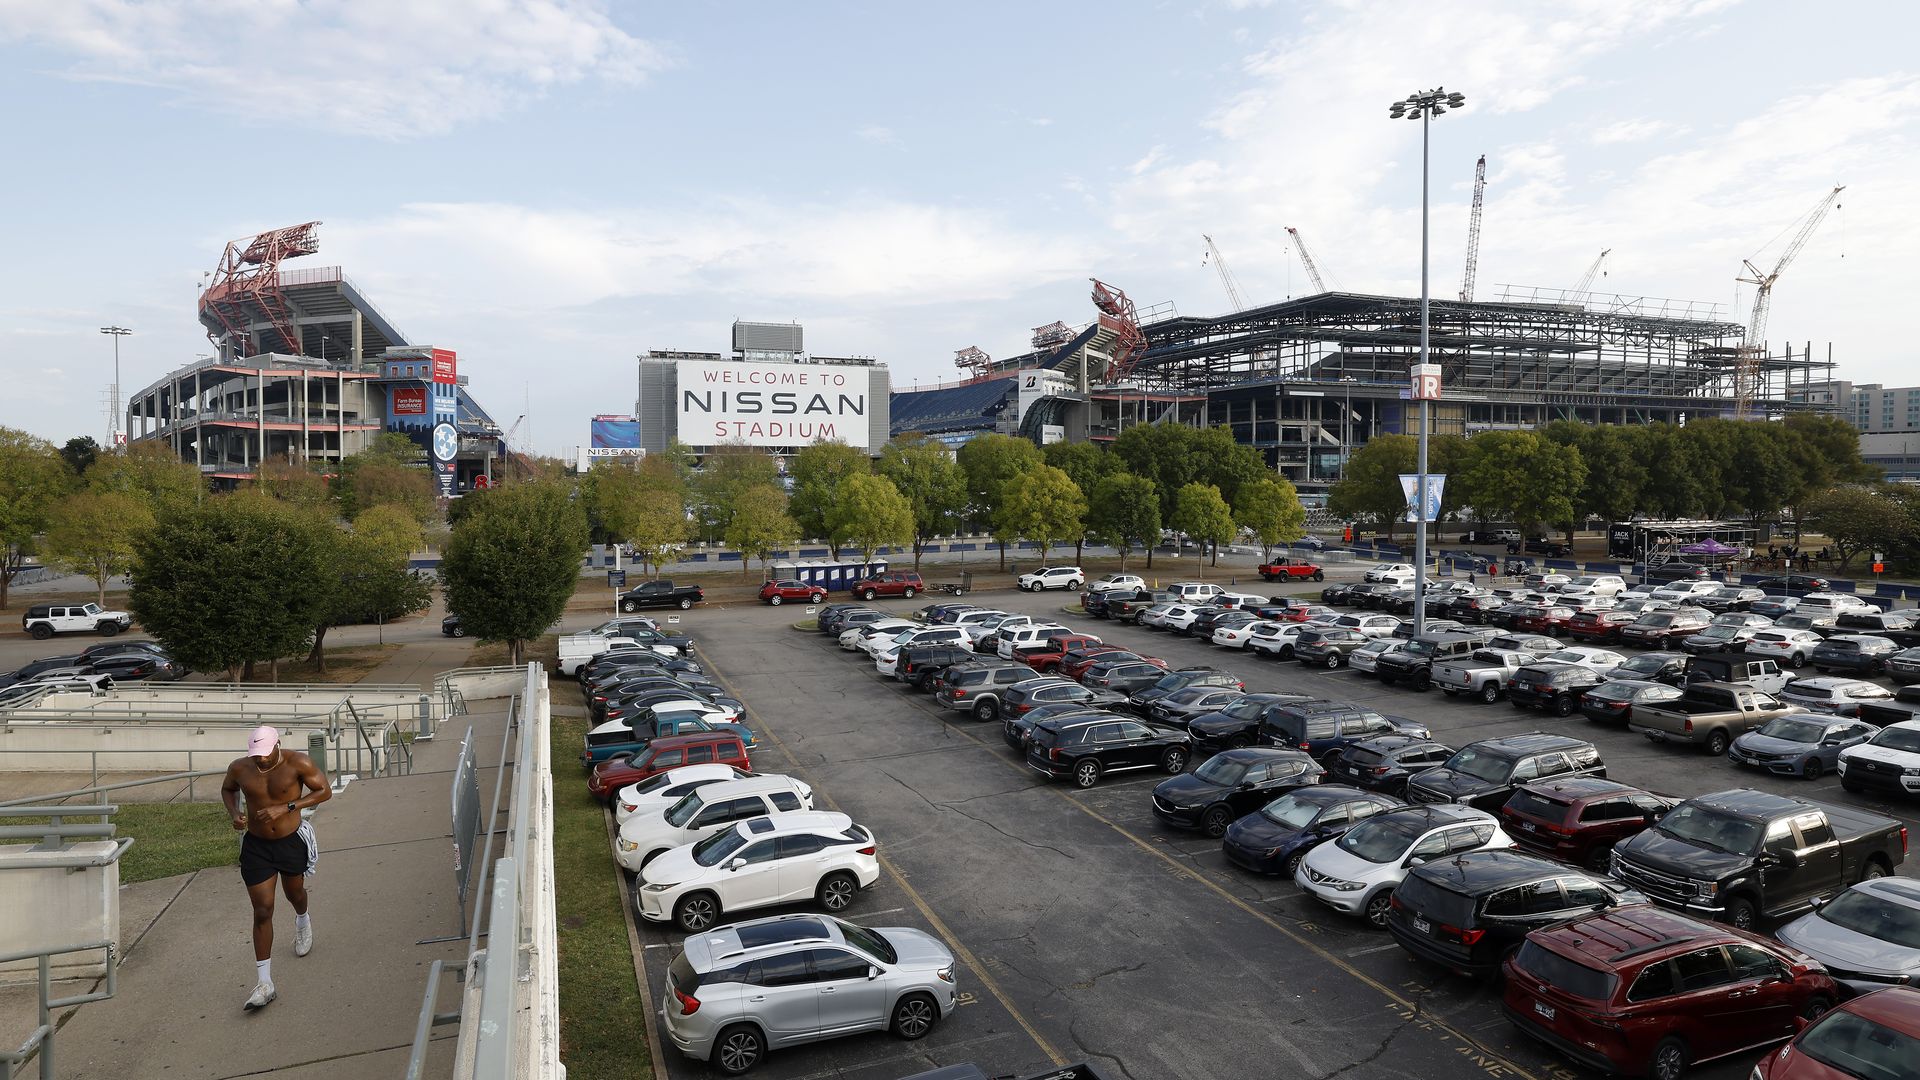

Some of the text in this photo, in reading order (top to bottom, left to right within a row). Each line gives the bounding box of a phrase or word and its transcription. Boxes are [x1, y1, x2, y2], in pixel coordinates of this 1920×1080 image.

[703, 370, 845, 386] WELCOME TO
[1412, 377, 1420, 399] R
[1424, 376, 1438, 398] R
[684, 390, 864, 416] NISSAN
[715, 421, 836, 438] STADIUM
[117, 435, 125, 444] K
[587, 448, 637, 456] NISSAN
